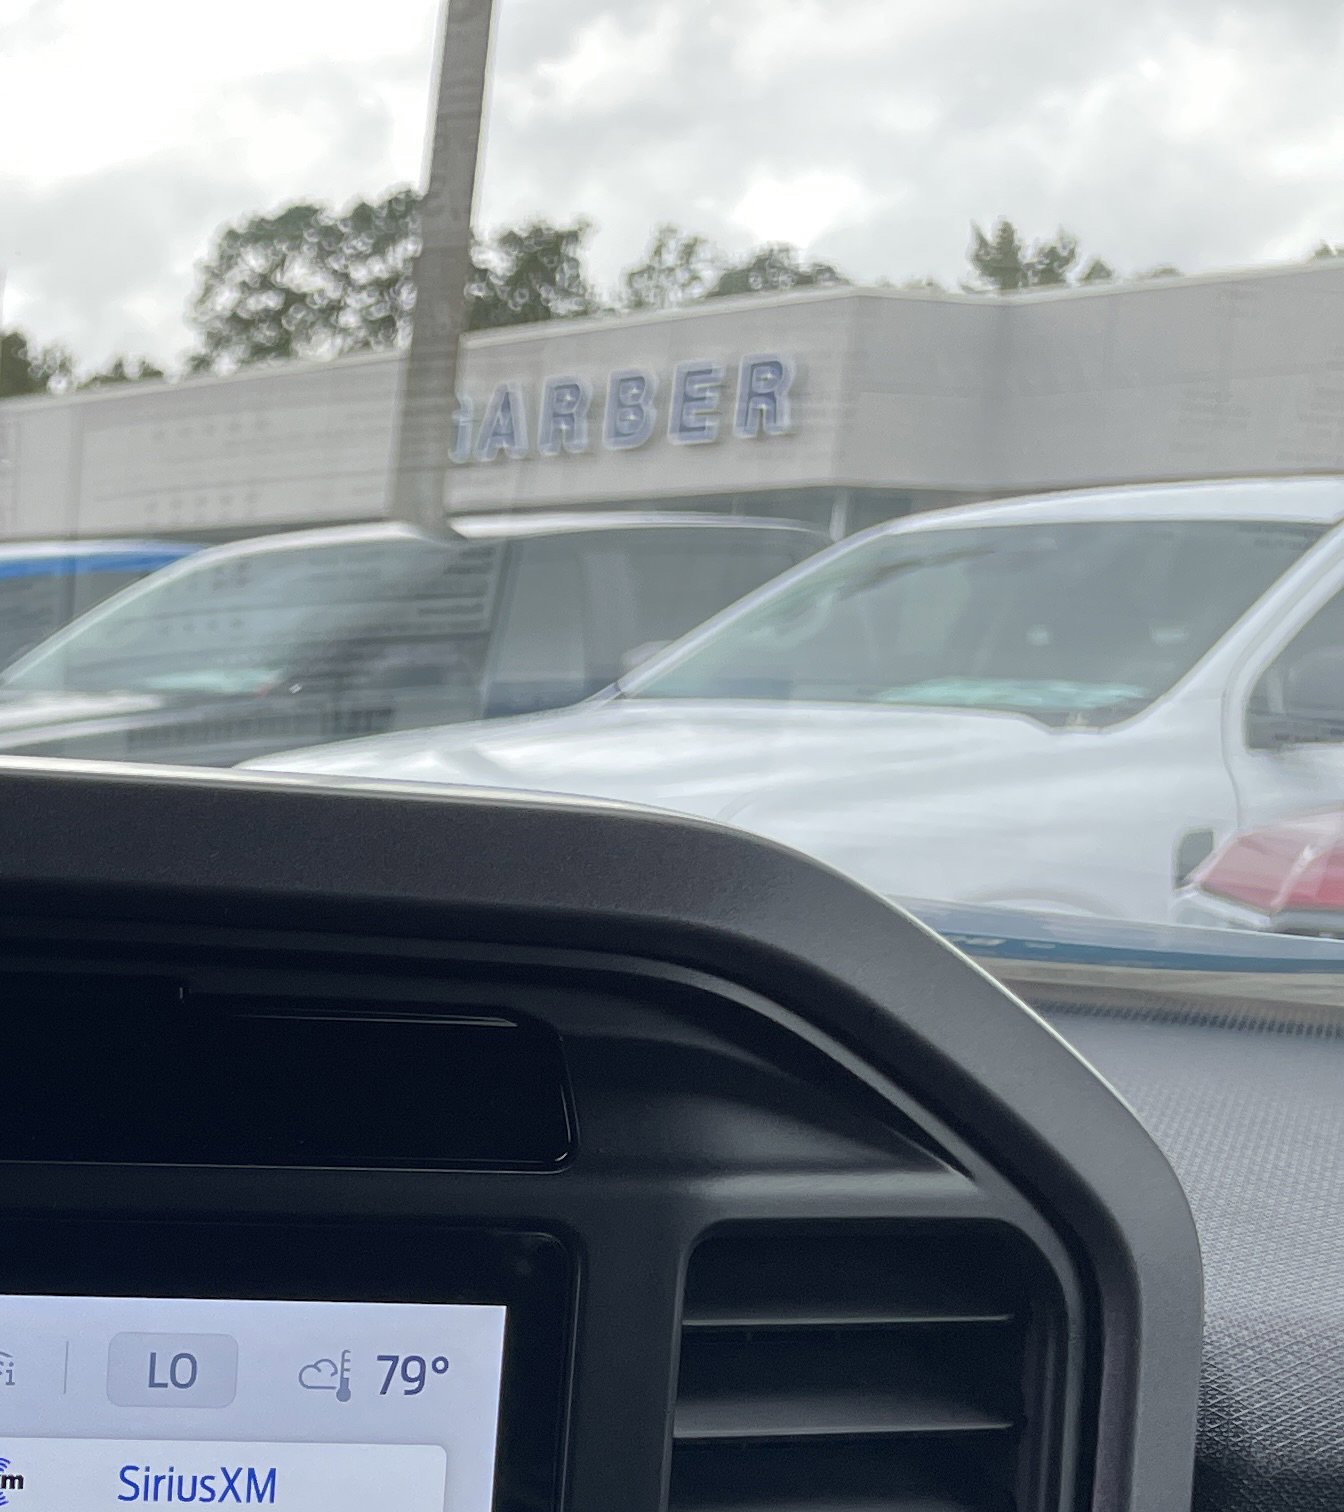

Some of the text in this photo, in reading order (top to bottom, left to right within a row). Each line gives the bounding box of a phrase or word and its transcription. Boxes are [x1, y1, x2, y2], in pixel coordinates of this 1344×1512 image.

[147, 1351, 198, 1390] LO
[376, 1354, 449, 1396] 79°
[117, 1465, 277, 1504] SiriusXM
